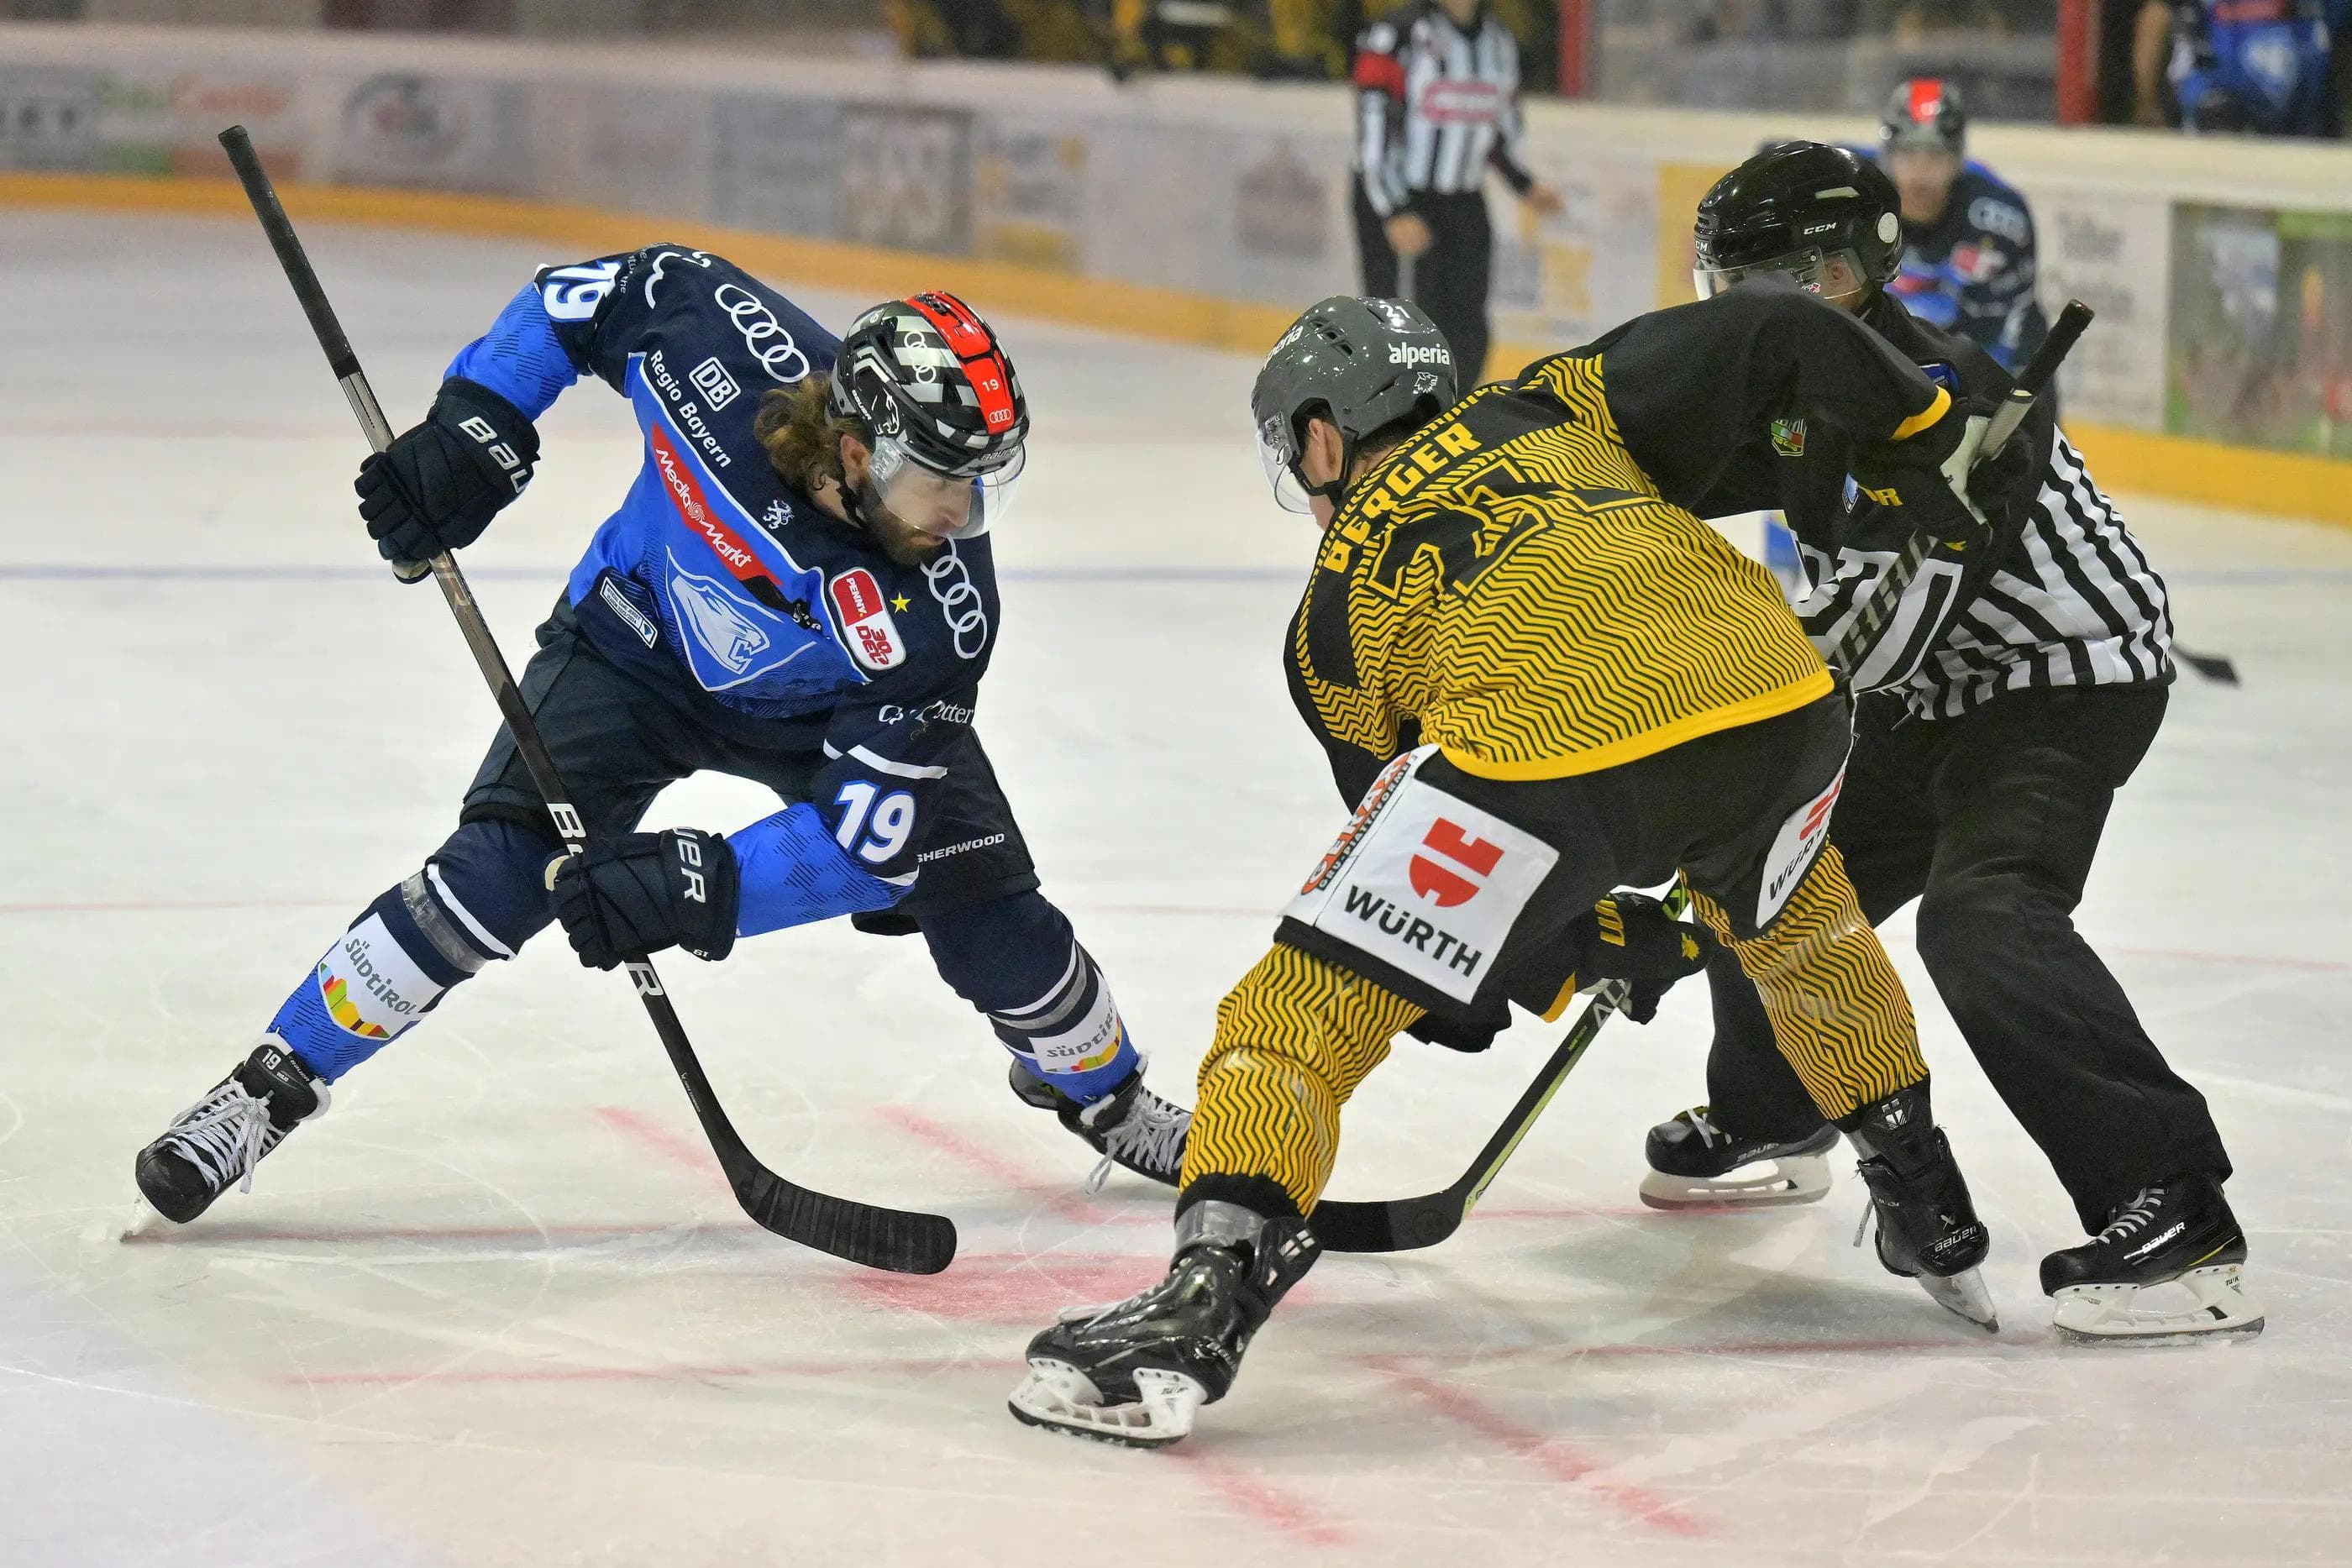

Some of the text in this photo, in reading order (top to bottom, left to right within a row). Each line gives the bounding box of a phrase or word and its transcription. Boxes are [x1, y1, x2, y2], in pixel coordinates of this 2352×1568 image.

[1804, 222, 1837, 235] CCM
[1694, 239, 1709, 252] CM
[543, 260, 622, 323] 19
[1379, 302, 1410, 319] 21
[1389, 341, 1451, 369] alperia
[696, 363, 732, 403] DB
[982, 379, 1000, 392] 19
[650, 349, 682, 401] Regio
[679, 401, 732, 468] Bayern
[1324, 422, 1482, 573] BERGER
[870, 627, 893, 653] 30
[833, 779, 916, 865] 19
[916, 833, 1005, 863] SHERWOOD
[1344, 885, 1483, 978] WÜRTH
[261, 1048, 281, 1070] 19
[1935, 1225, 1977, 1252] BAUER
[2142, 1222, 2186, 1253] BAUER
